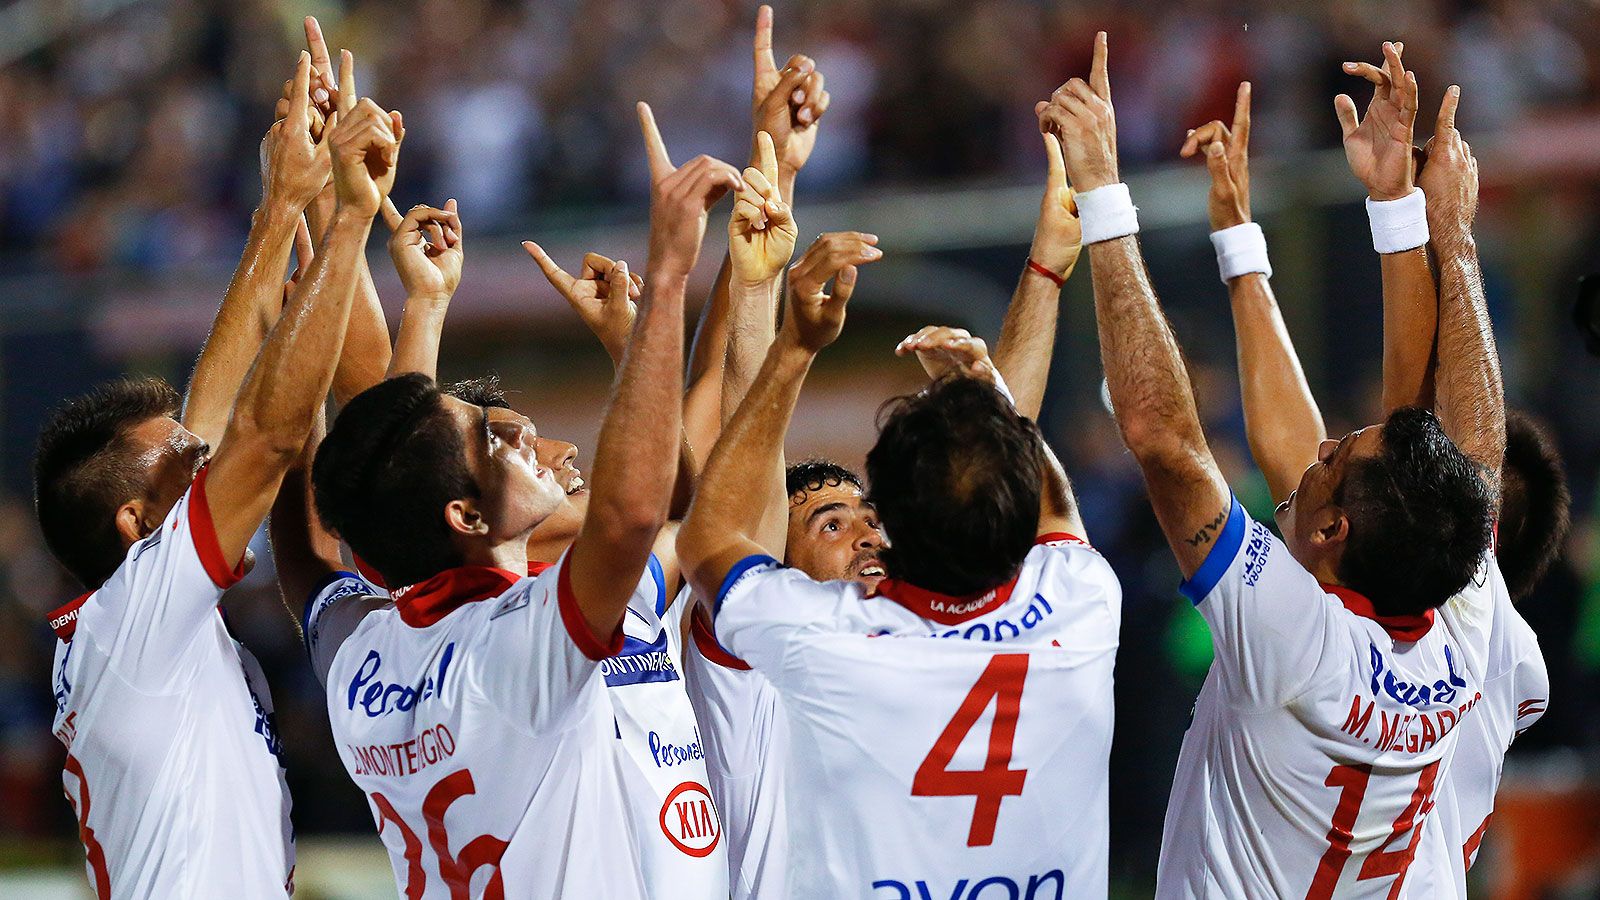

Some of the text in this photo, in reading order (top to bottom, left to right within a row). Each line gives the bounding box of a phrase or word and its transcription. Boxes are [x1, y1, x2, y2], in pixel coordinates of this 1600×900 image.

[930, 600, 945, 613] LA
[648, 726, 704, 768] Personal
[911, 653, 1030, 847] 4
[675, 800, 716, 840] KIA
[1304, 758, 1436, 900] 14
